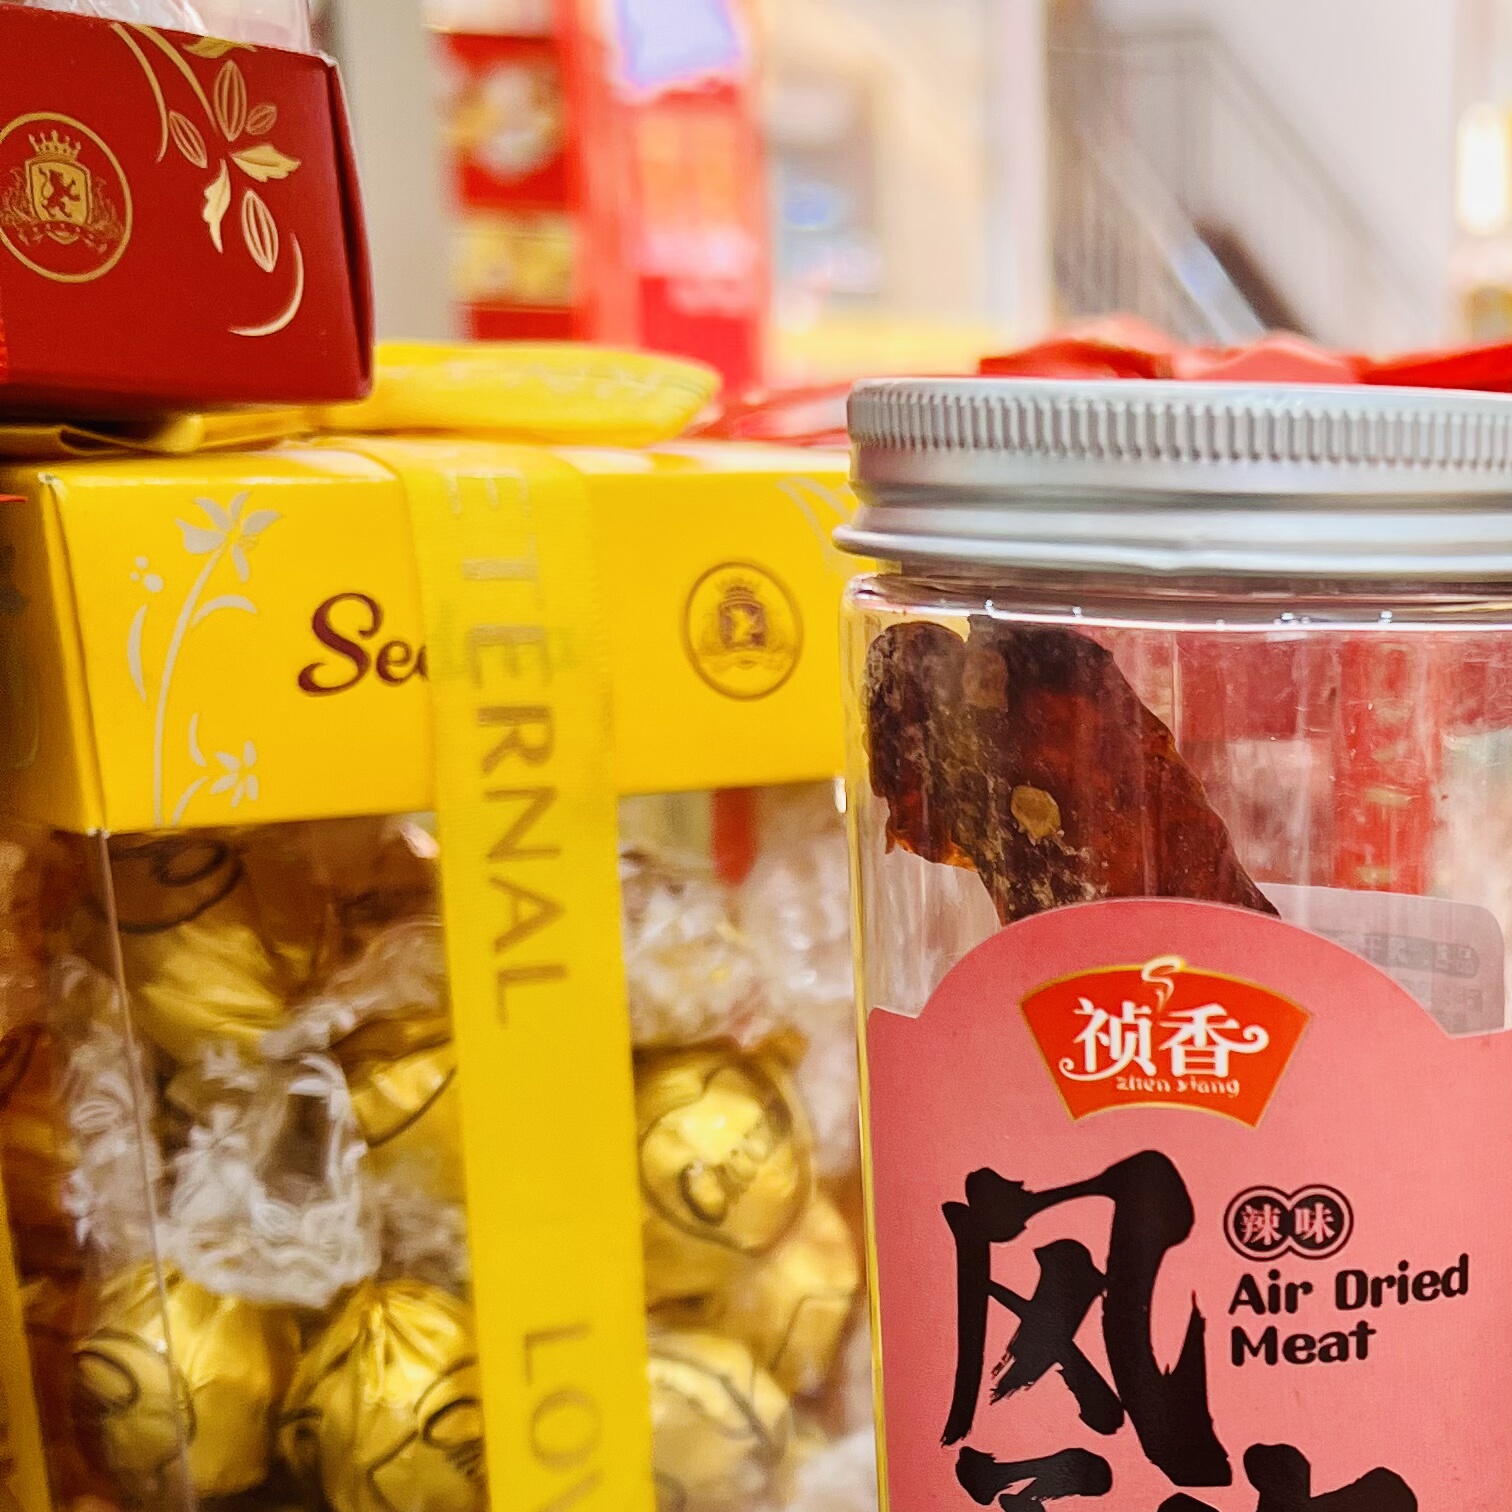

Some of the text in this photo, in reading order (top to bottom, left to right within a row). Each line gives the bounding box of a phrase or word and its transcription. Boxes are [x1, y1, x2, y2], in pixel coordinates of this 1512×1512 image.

[445, 466, 569, 1028] ETERNAL
[1058, 997, 1270, 1082] 祯香
[1235, 1196, 1340, 1248] 辣味
[941, 1150, 1232, 1487] 风
[1228, 1254, 1470, 1315] Air Dried
[1231, 1320, 1377, 1367] Meat
